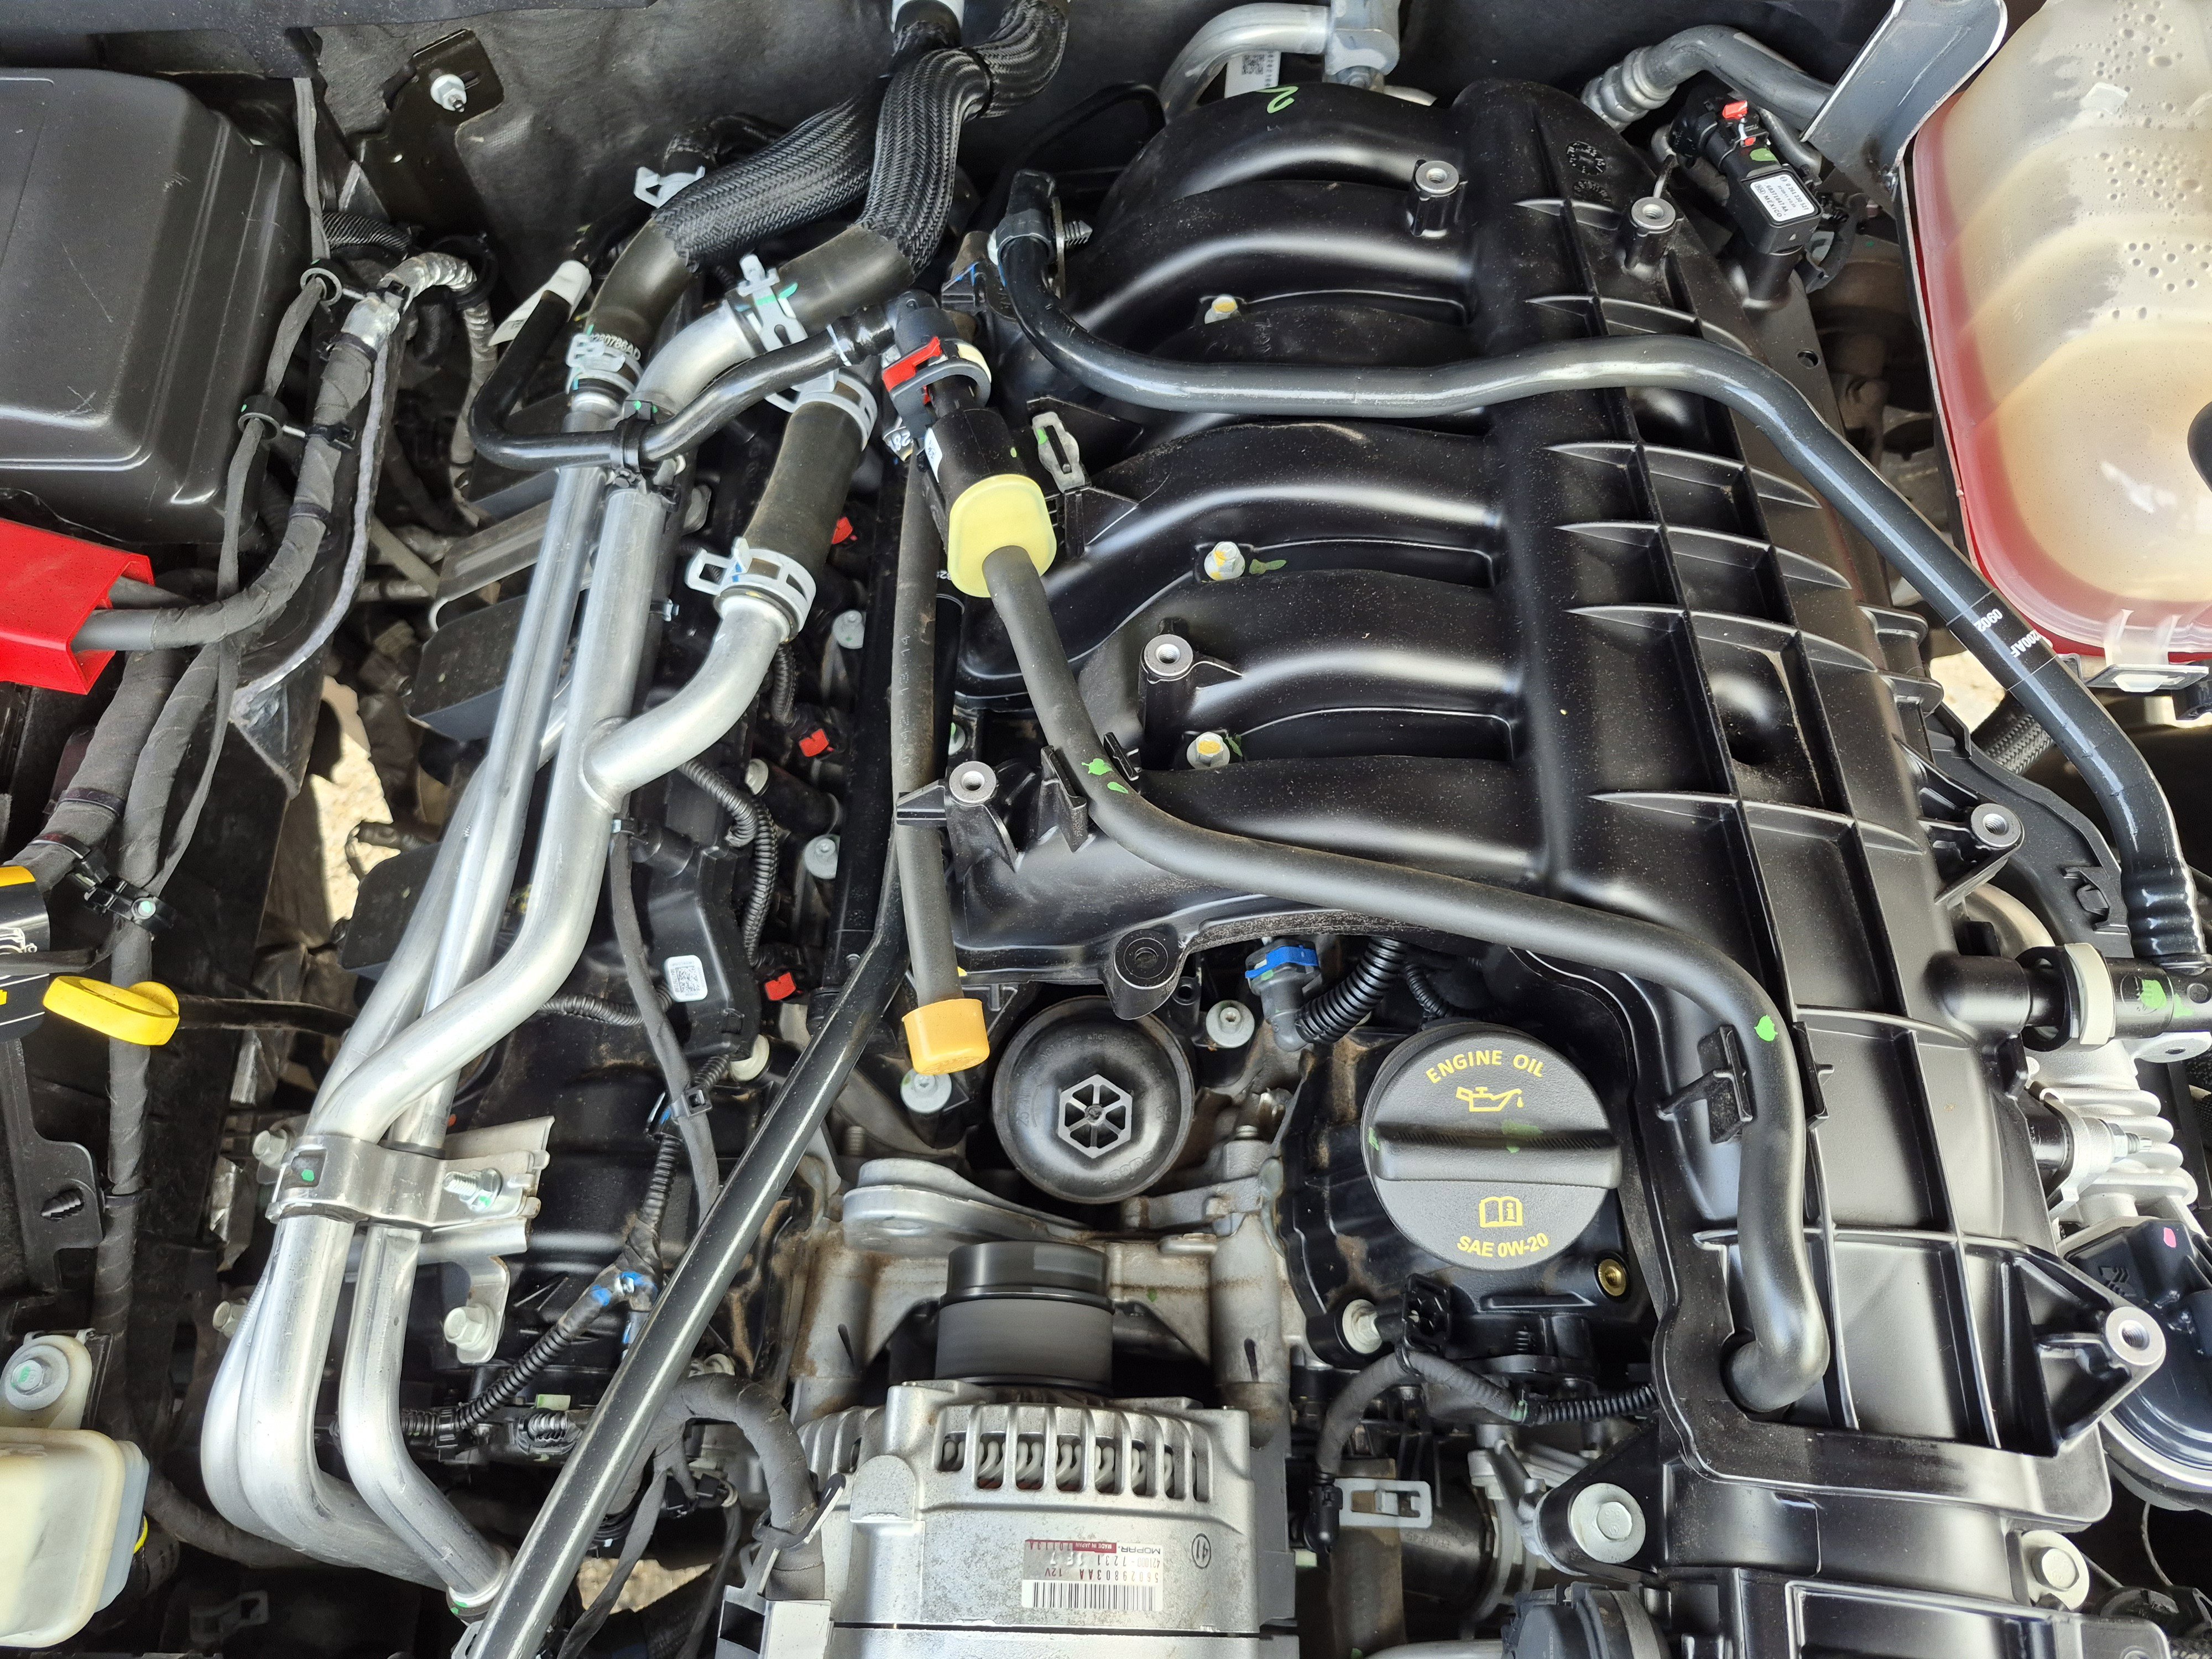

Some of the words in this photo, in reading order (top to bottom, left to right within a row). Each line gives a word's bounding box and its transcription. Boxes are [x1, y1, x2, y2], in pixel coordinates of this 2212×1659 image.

[1764, 195, 1782, 217] MEXICO
[1973, 608, 2003, 632] 0902
[1426, 1050, 1503, 1084] ENGINE
[1512, 1053, 1546, 1078] OIL
[1457, 1235, 1494, 1258] SAE
[1498, 1232, 1550, 1258] 0W-20
[1045, 1567, 1062, 1578] 12V
